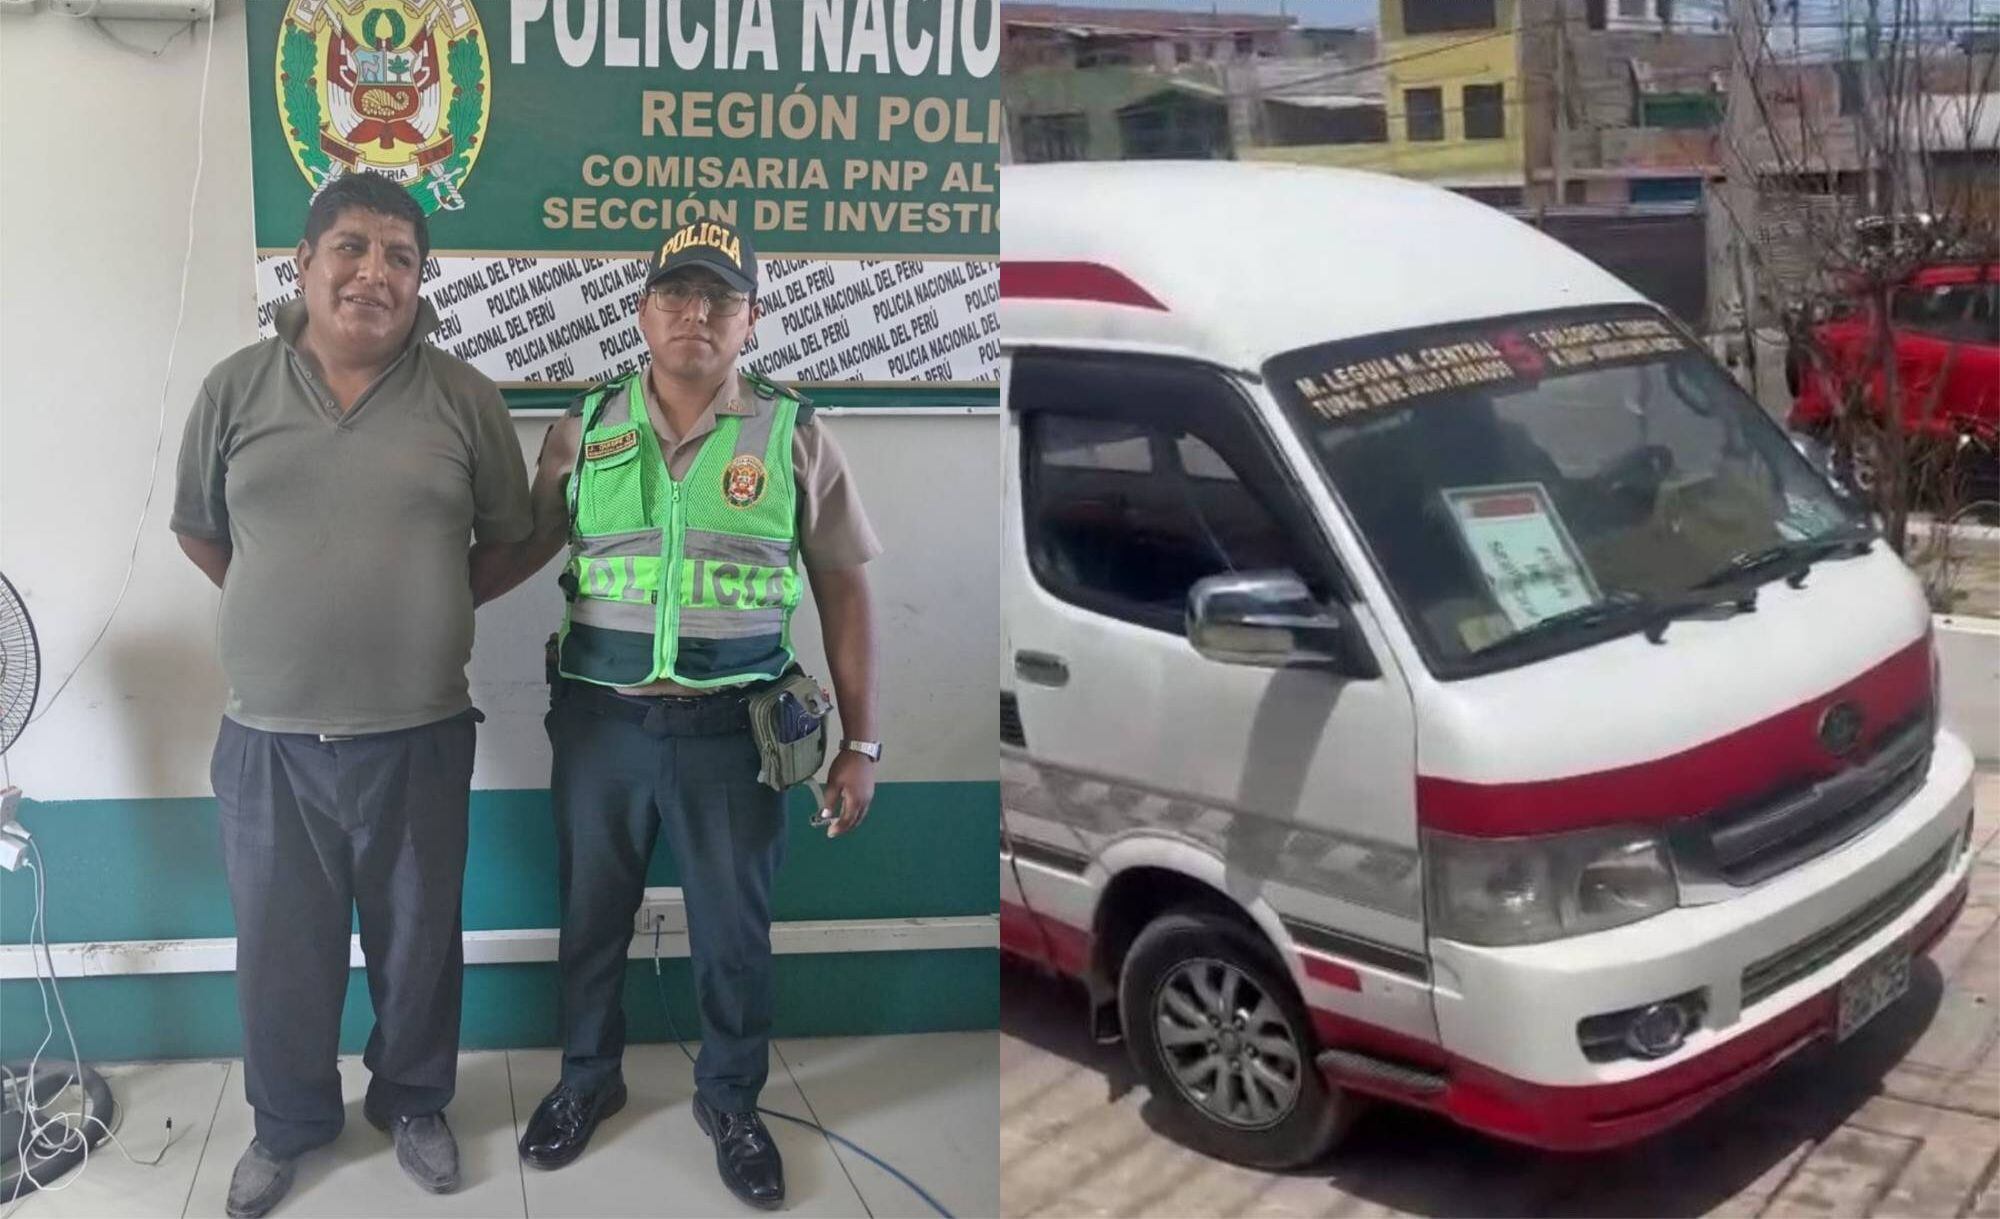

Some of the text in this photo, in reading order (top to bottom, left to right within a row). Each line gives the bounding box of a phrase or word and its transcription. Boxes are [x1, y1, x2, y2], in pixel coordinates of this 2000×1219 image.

[641, 83, 1000, 145] REGIÓN POLI
[582, 154, 829, 191] COMISARIA
[844, 160, 928, 191] PNP
[542, 191, 738, 230] SECCIÓN
[754, 202, 808, 231] DE
[658, 222, 742, 269] POLICIA
[433, 270, 488, 311] NACIONAL
[486, 260, 510, 286] DEL
[486, 282, 531, 318] POLICIA
[527, 260, 582, 299] NACIONAL
[581, 269, 625, 305] POLICIA
[781, 300, 825, 335] POLICIA
[821, 277, 875, 317] NACIONAL
[874, 267, 897, 293] DEL
[785, 279, 807, 305] DEL
[805, 261, 836, 295] PERÚ
[872, 260, 987, 324] POLICIA NACIONAL DEL
[453, 295, 556, 361] NACIONAL DEL PERÚ
[504, 336, 549, 371] POLICIA
[545, 312, 600, 352] NACIONAL
[597, 302, 621, 328] DEL
[599, 325, 643, 361] POLICIA
[748, 342, 802, 376] NACIONAL
[799, 332, 823, 357] DEL
[821, 314, 850, 347] PERÚ
[796, 356, 840, 381] POLICIA
[837, 332, 890, 372] NACIONAL
[889, 323, 912, 348] DEL
[909, 304, 939, 338] PERÚ
[887, 344, 930, 379] POLICIA
[928, 321, 982, 360] NACIONAL
[980, 311, 1000, 336] DEL
[1418, 340, 1502, 368] CENTRAL
